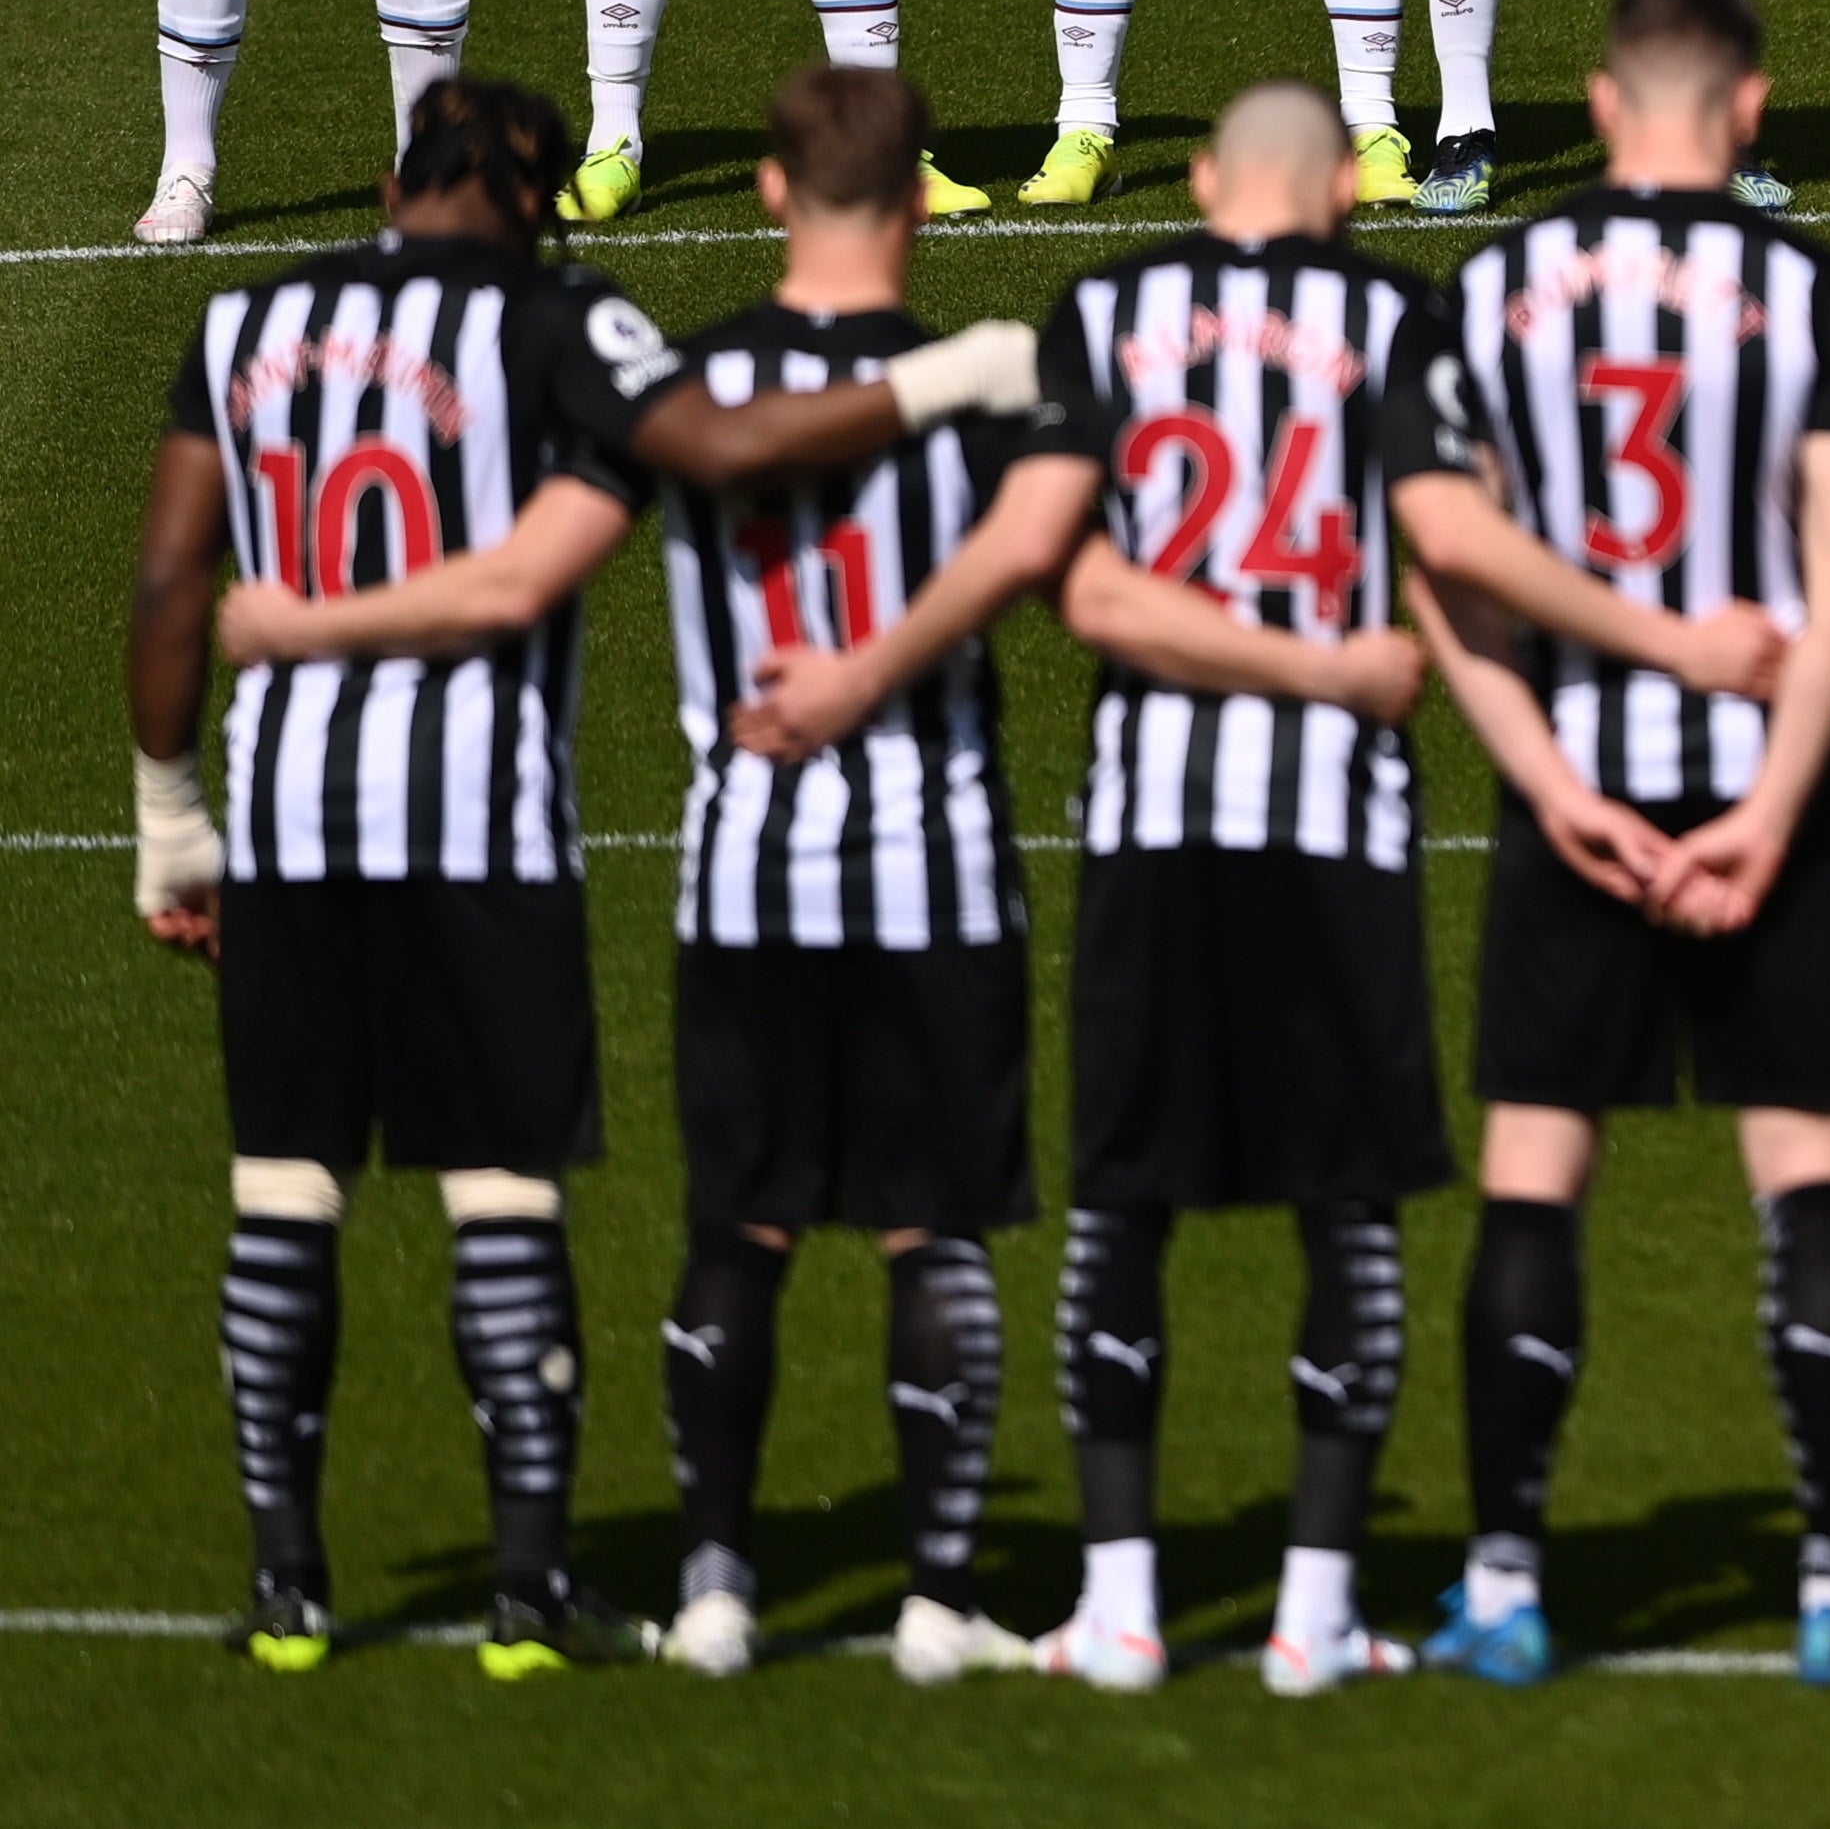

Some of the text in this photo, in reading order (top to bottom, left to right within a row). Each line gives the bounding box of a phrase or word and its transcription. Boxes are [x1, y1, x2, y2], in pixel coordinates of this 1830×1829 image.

[252, 432, 445, 602] 10
[1118, 406, 1363, 626] 24
[1580, 351, 1691, 569] 3
